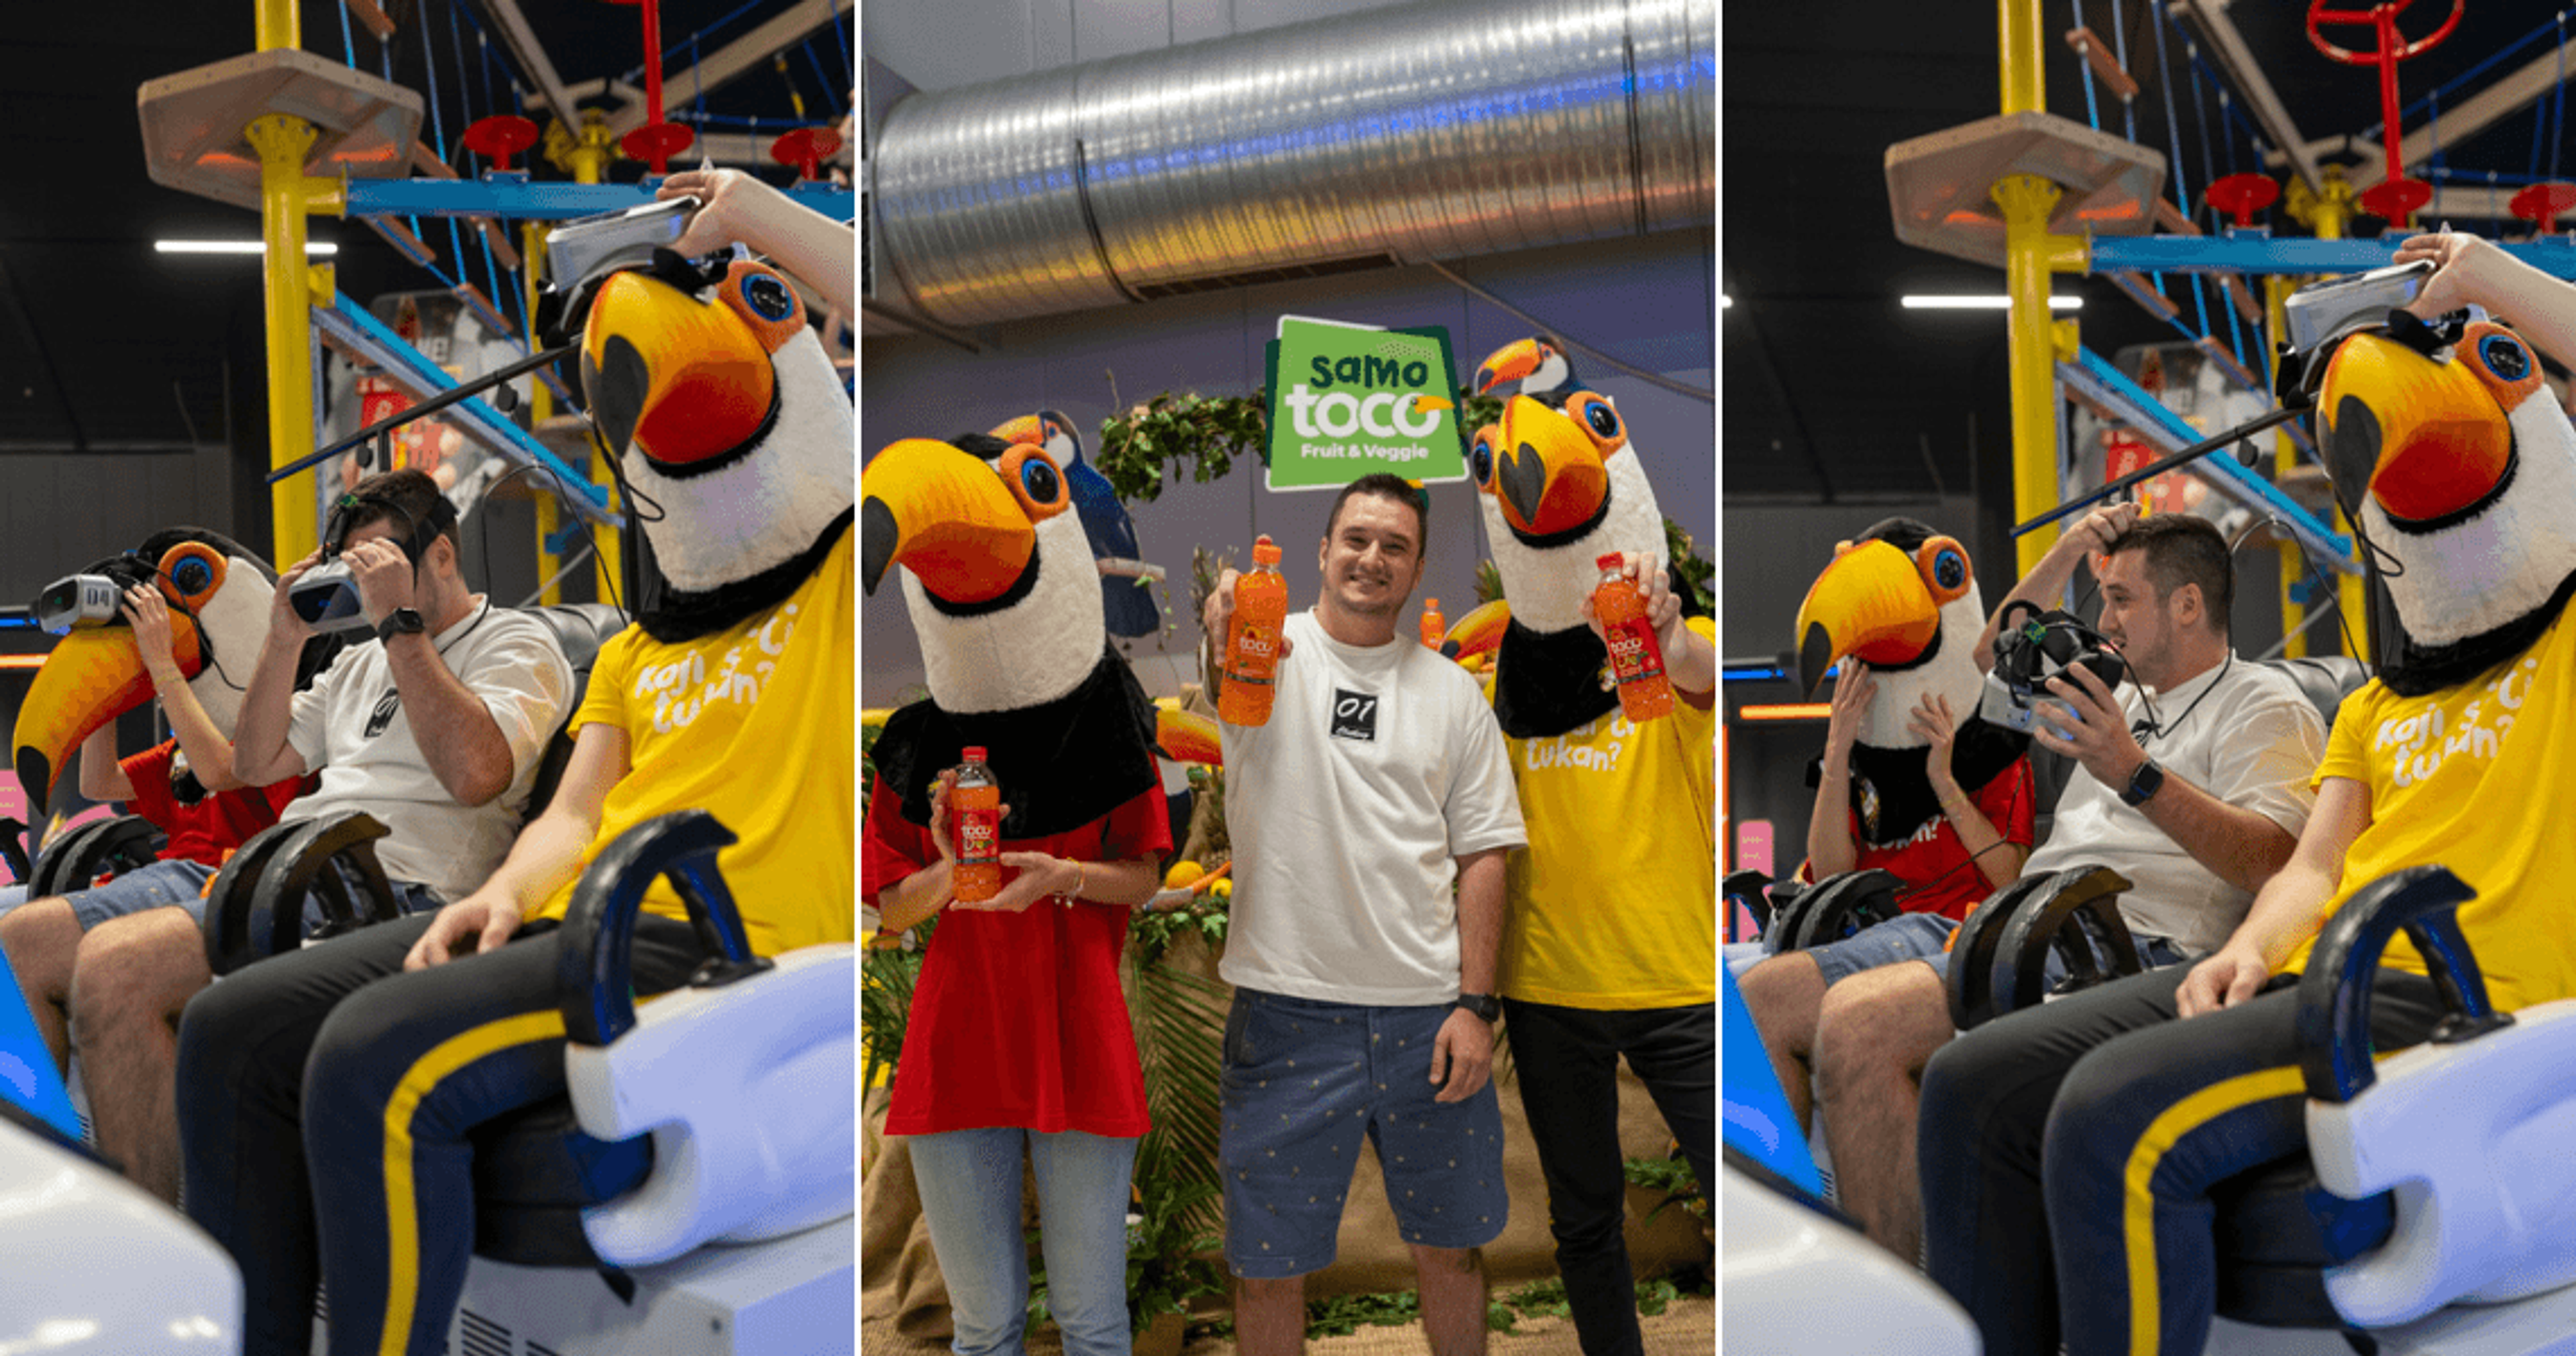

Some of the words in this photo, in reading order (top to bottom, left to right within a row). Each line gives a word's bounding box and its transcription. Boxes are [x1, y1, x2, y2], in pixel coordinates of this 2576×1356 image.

[1285, 384, 1442, 438] toco
[1301, 444, 1345, 459] Fruit
[1348, 444, 1361, 458] &
[1363, 443, 1429, 462] Veggie
[1337, 698, 1375, 721] 01
